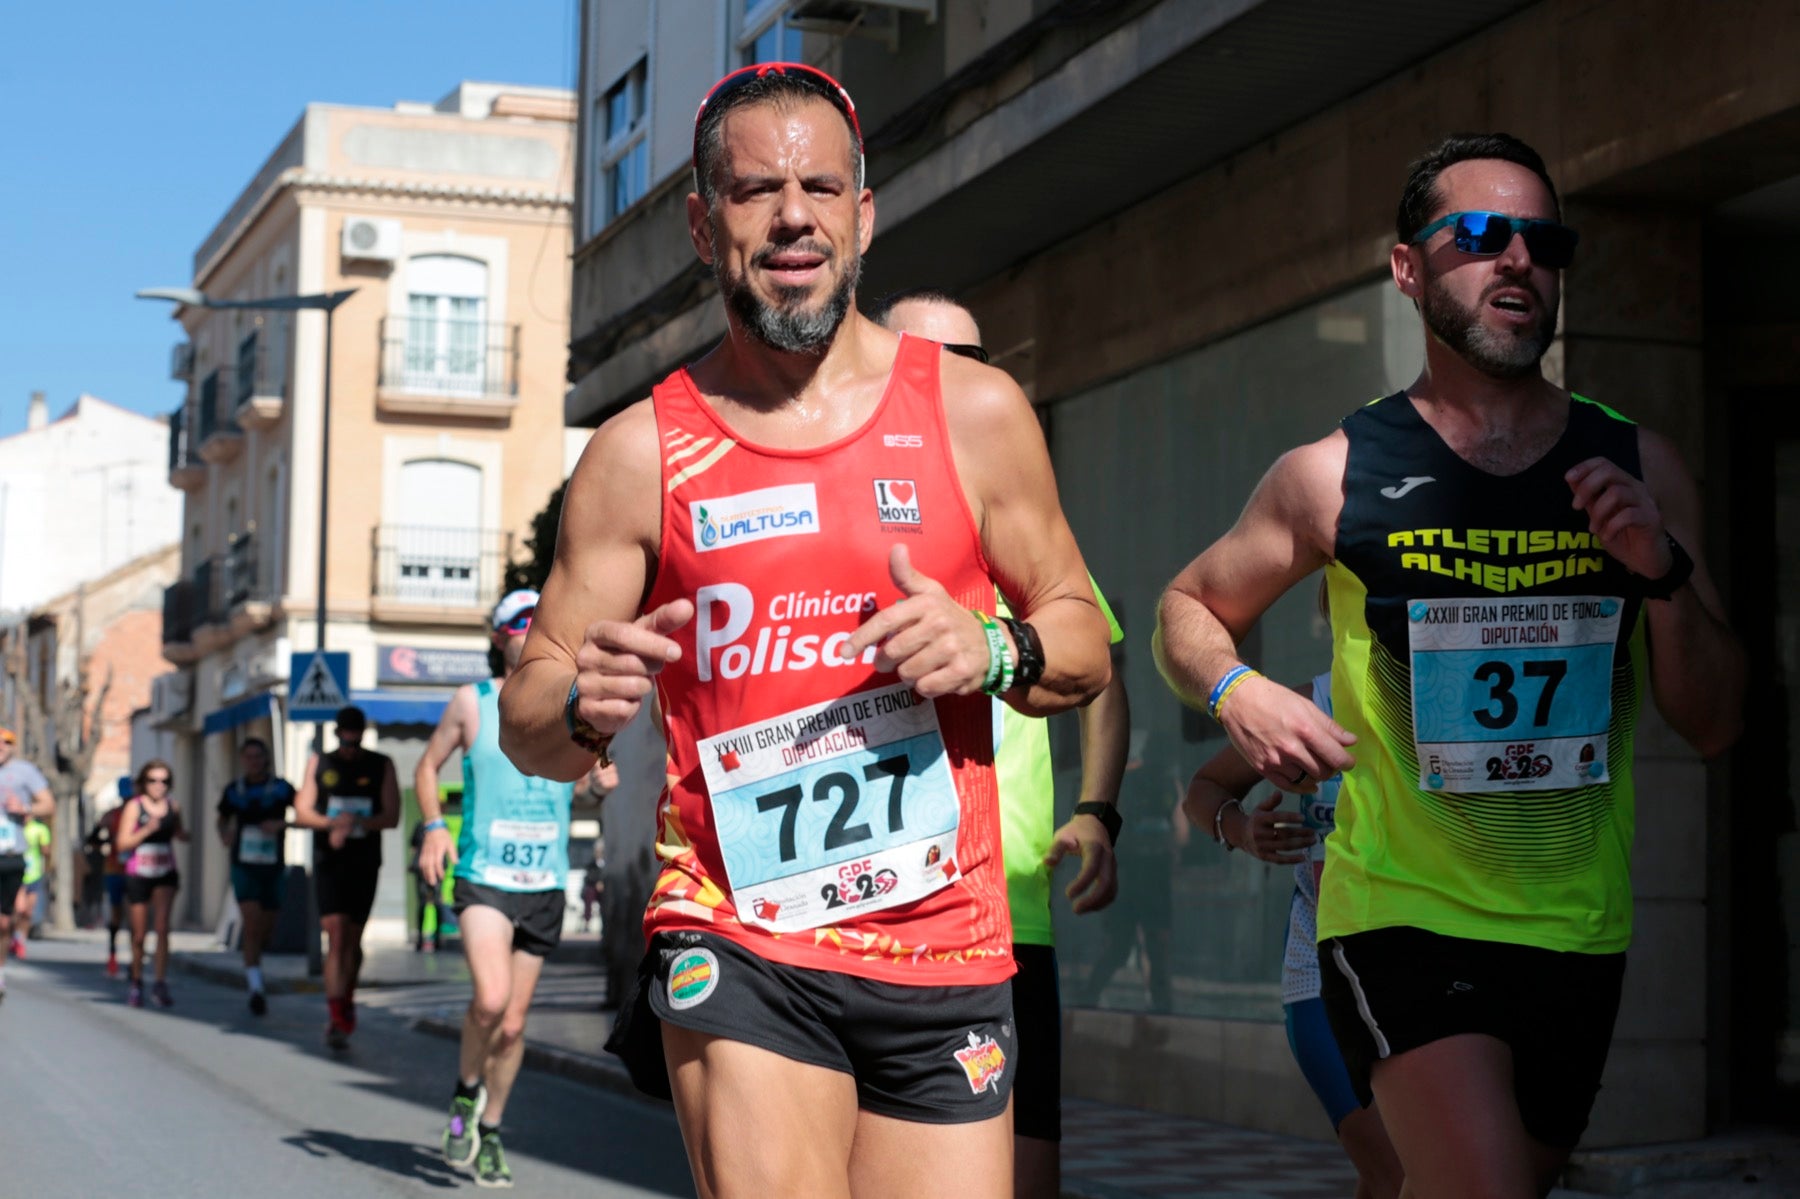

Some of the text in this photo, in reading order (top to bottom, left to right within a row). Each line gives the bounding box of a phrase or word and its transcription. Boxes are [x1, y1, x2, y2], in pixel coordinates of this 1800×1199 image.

[878, 482, 888, 506] I
[879, 507, 921, 522] MOVE
[880, 525, 924, 535] RUNNING
[1401, 553, 1603, 593] ALHENDÍN
[768, 589, 877, 621] Clínicas
[1463, 605, 1498, 623] GRAN
[1501, 604, 1548, 622] PREMIO
[1552, 603, 1569, 621] DE
[1481, 624, 1559, 645] DIPUTACIÓN
[1471, 659, 1567, 731] 37
[756, 721, 796, 750] GRAN
[797, 706, 852, 736] PREMIO
[852, 700, 873, 721] DE
[781, 726, 868, 767] DIPUTACIÓN
[756, 753, 911, 863] 727
[502, 843, 548, 867] 837
